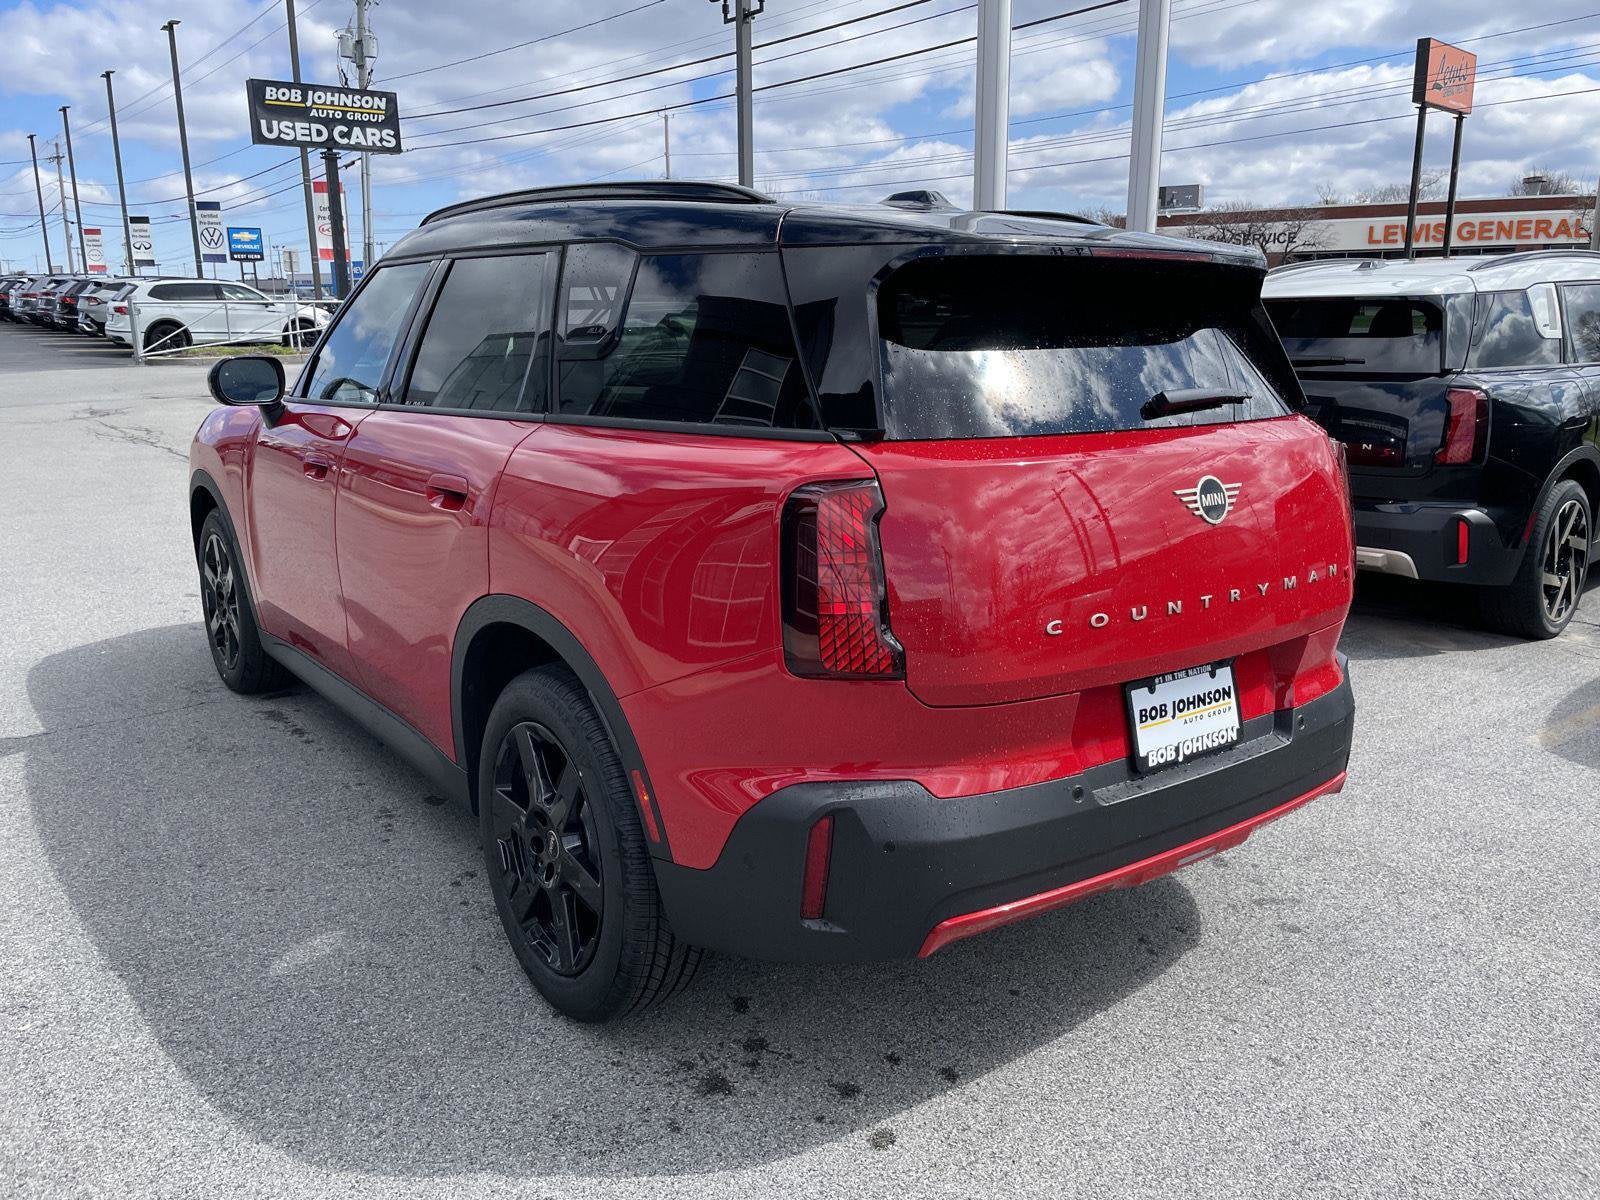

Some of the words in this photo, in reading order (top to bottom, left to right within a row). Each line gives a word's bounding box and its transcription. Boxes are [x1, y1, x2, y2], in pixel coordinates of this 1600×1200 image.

[265, 86, 302, 102] BOB
[305, 90, 387, 110] JOHNSON
[309, 109, 342, 119] AUTO
[346, 112, 385, 122] GROUP
[260, 119, 329, 143] USED
[332, 125, 397, 148] CARS
[1367, 223, 1446, 244] LEWIS
[1457, 218, 1592, 241] GENERAL
[1201, 492, 1225, 507] MINI
[1046, 563, 1337, 635] COUNTRYMAN
[1174, 670, 1187, 679] THE
[1188, 664, 1211, 676] NATION
[1139, 703, 1168, 724] BOB
[1171, 685, 1232, 720] JOHNSON
[1183, 714, 1204, 725] AUTO
[1207, 706, 1232, 718] GROUP
[1148, 747, 1176, 767] BOB
[1178, 727, 1238, 762] JOHNSON
